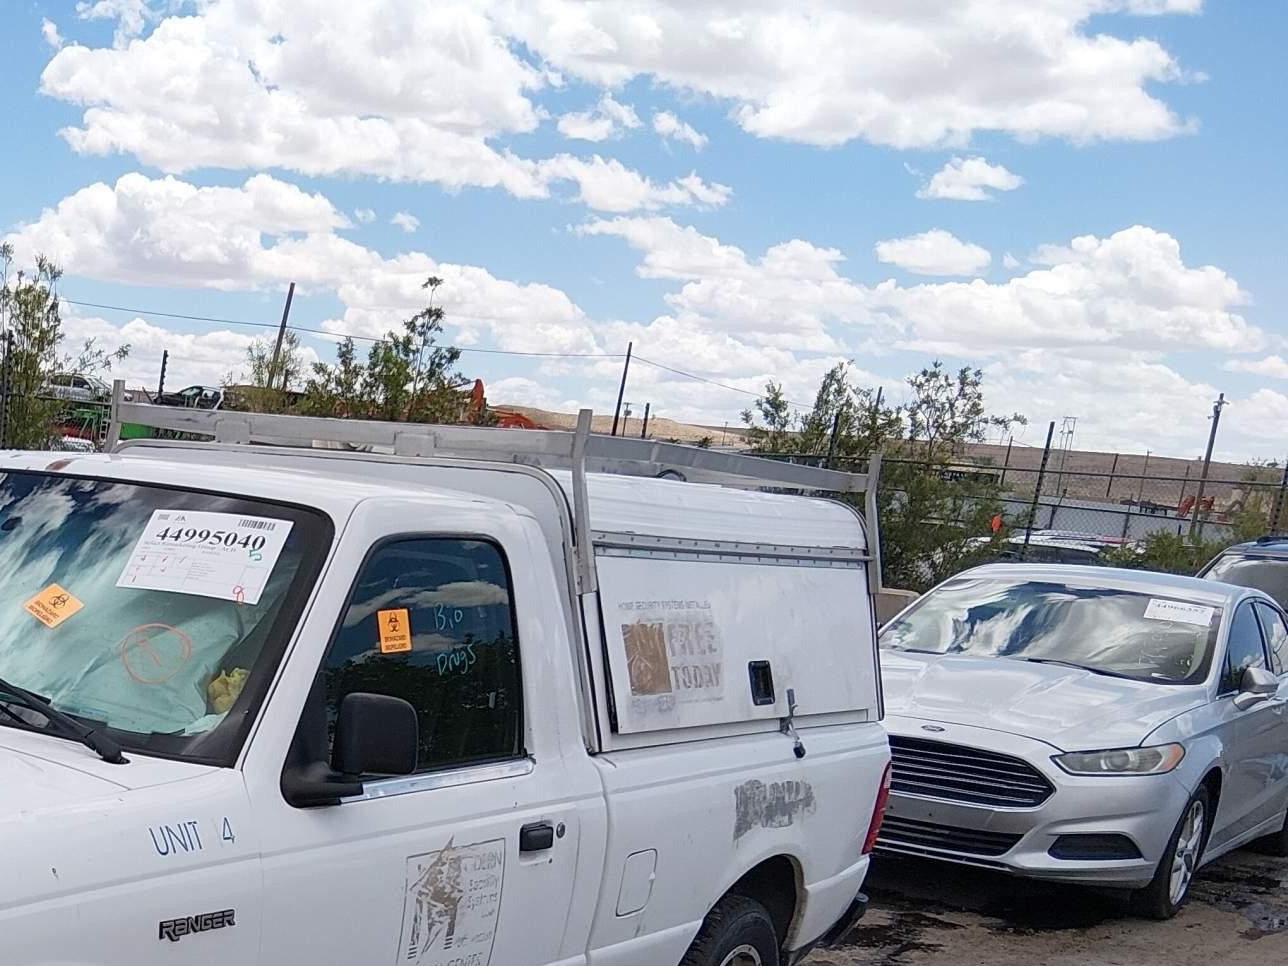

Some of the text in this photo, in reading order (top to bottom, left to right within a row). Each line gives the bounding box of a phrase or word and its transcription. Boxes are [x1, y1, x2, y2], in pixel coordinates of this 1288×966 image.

[156, 526, 266, 551] 44995040
[434, 602, 463, 630] Bio
[437, 643, 476, 676] Drugs
[671, 663, 722, 690] TODAY
[149, 816, 235, 856] UNIT 4
[159, 909, 236, 942] RANGER
